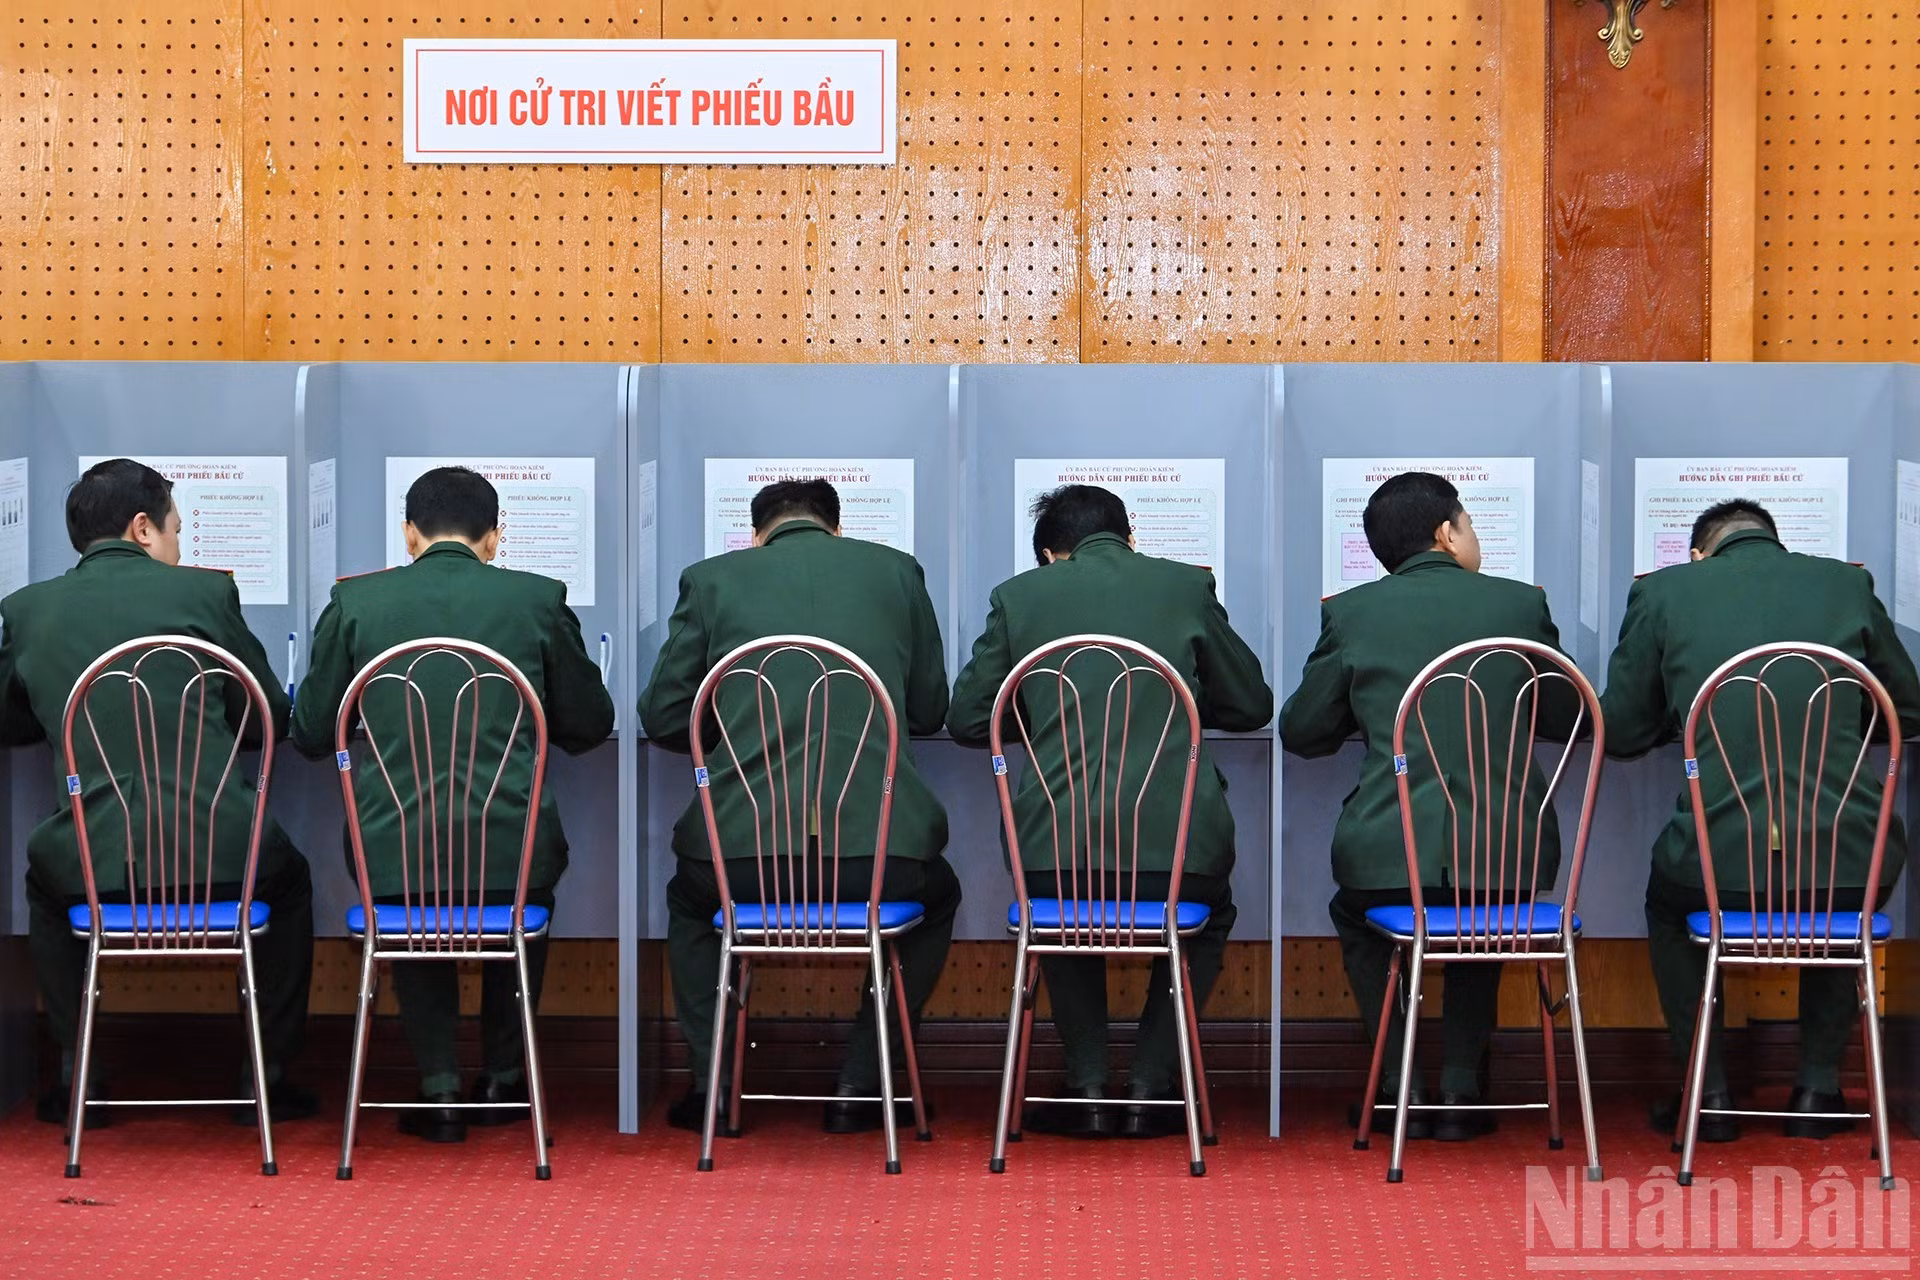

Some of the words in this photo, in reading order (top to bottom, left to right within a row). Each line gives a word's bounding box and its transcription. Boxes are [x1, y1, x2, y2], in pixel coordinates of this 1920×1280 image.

[445, 86, 498, 126] NƠI
[508, 77, 553, 126] CỬ
[560, 89, 606, 126] TRI
[617, 78, 681, 126] VIẾT
[691, 78, 782, 126] PHIẾU
[793, 78, 855, 126] BẦU
[1729, 474, 1743, 482] GHI
